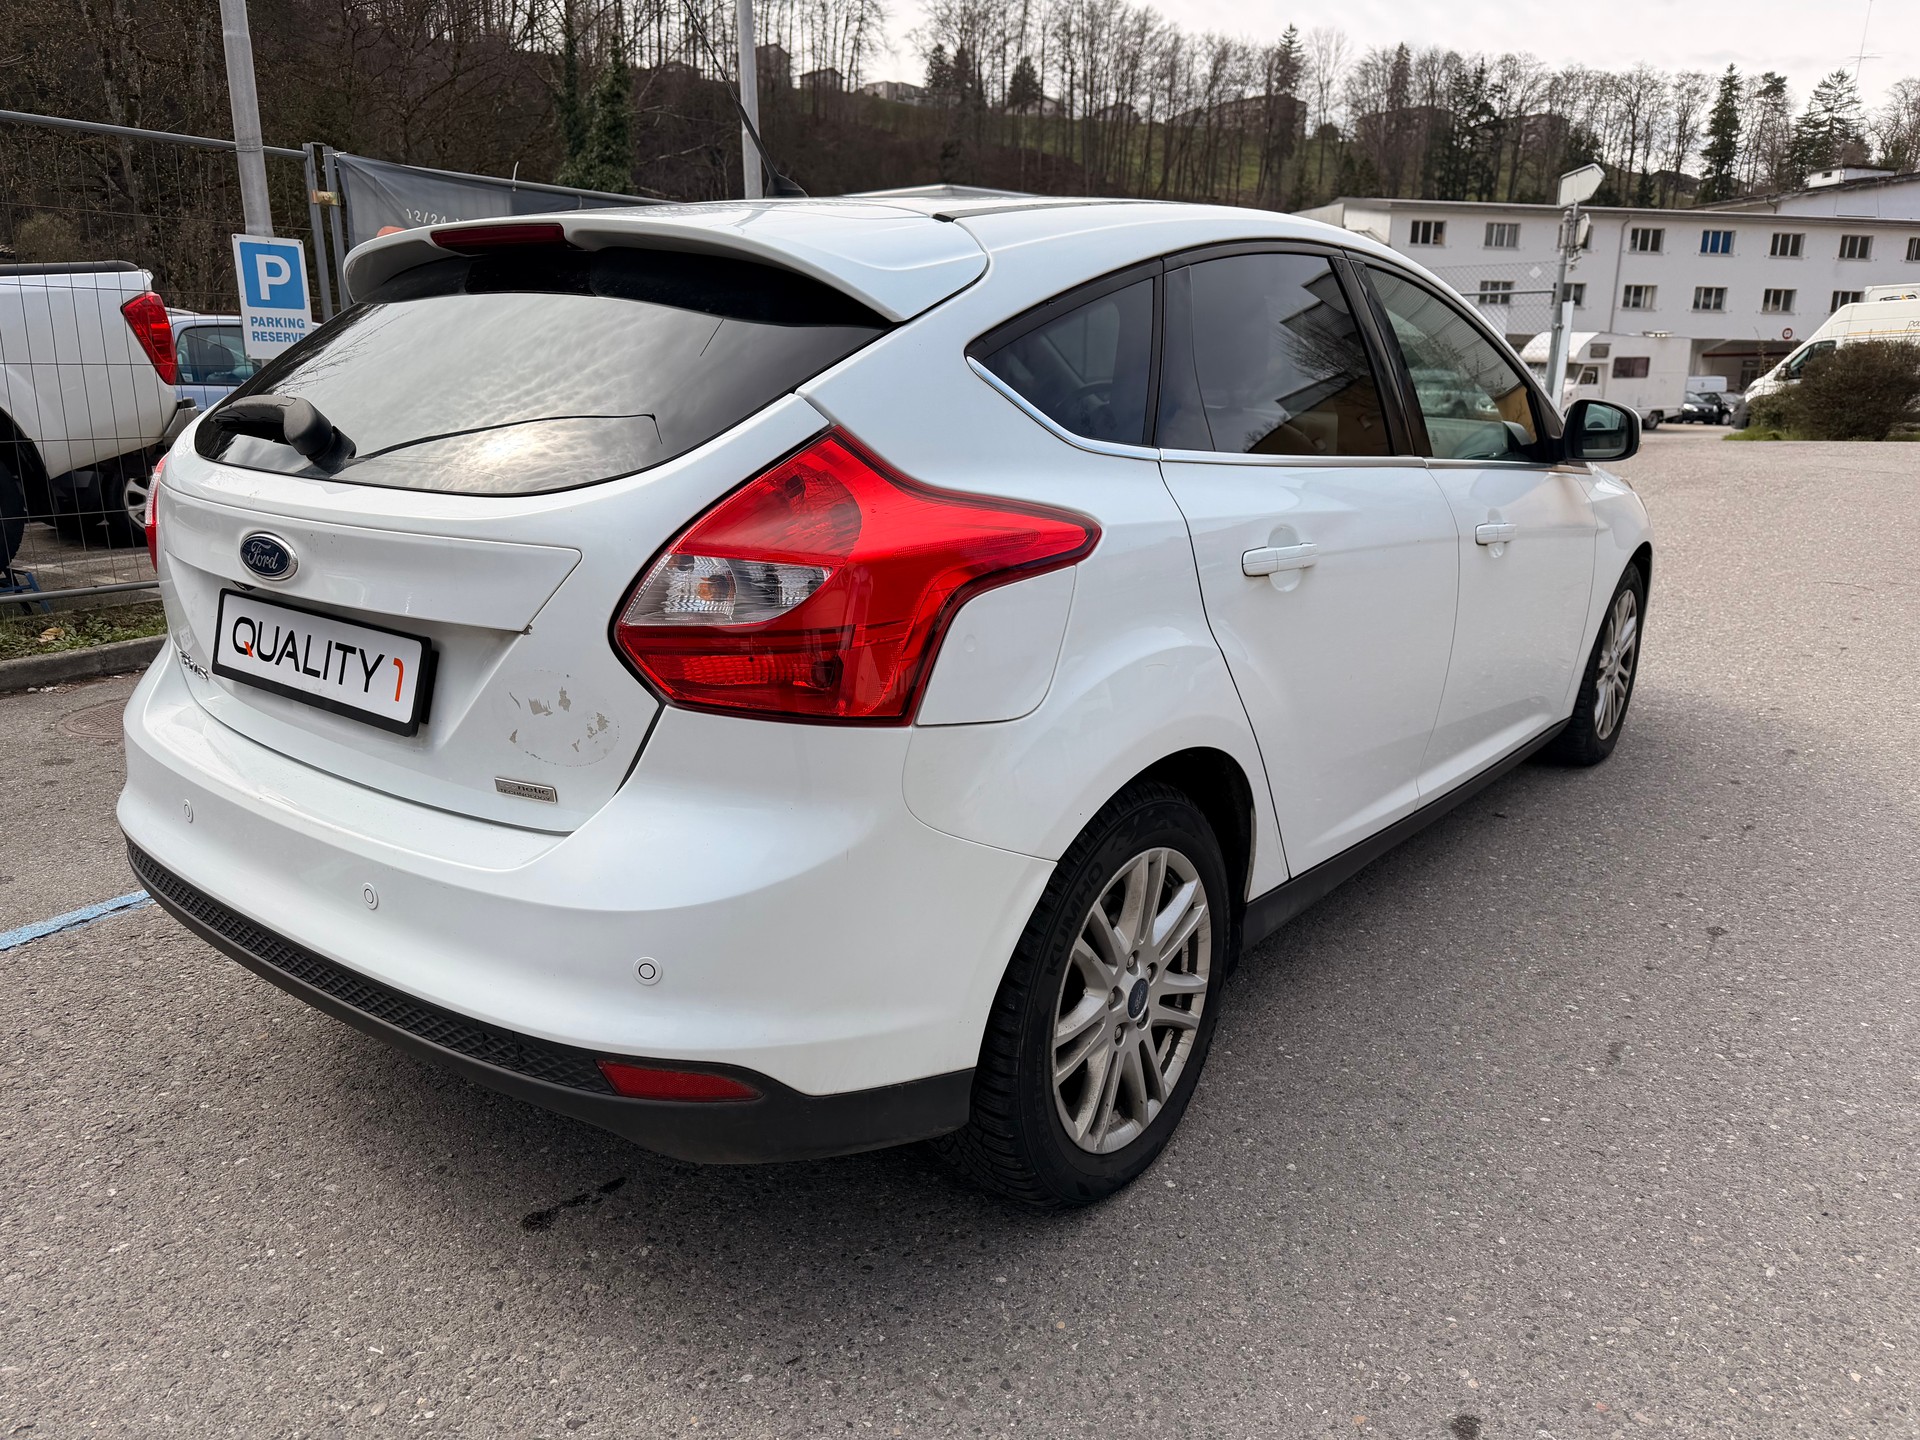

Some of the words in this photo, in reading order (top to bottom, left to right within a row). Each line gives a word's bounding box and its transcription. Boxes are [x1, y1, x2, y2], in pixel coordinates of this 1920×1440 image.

[255, 254, 291, 300] P
[250, 316, 305, 329] PARKING
[252, 331, 305, 343] RESERVE
[247, 541, 279, 569] Ford
[1047, 861, 1104, 976] KUMHO
